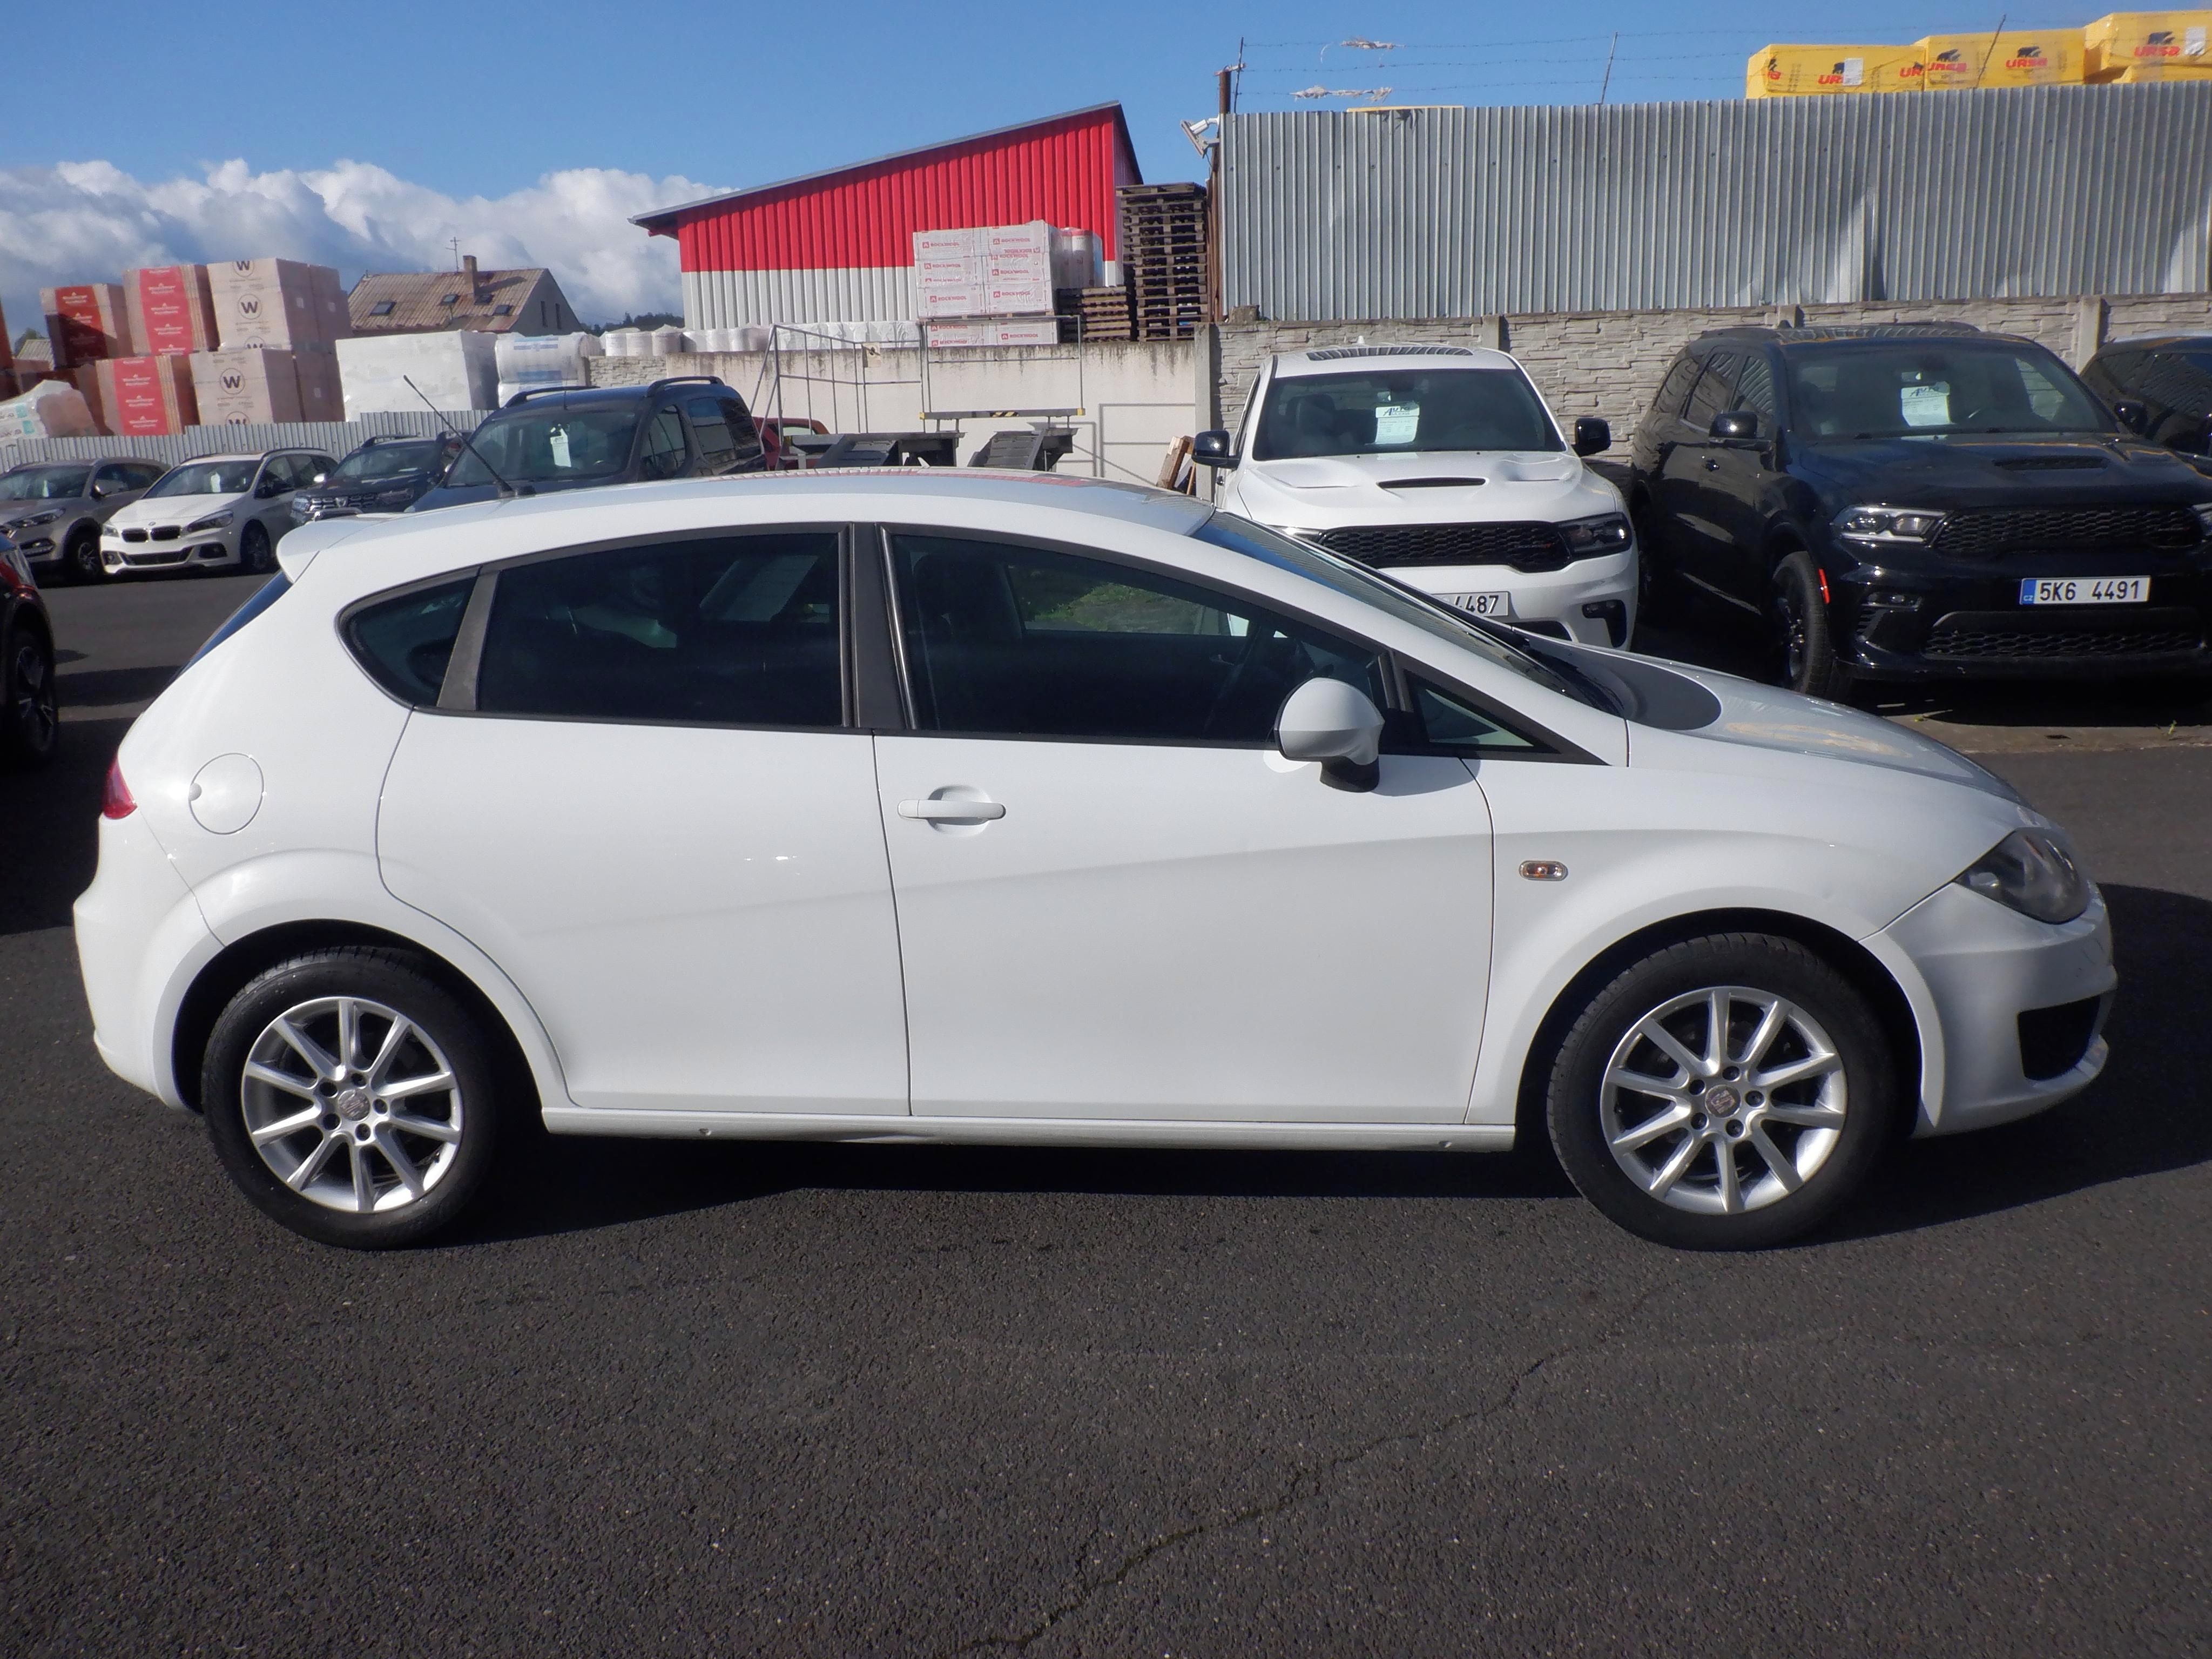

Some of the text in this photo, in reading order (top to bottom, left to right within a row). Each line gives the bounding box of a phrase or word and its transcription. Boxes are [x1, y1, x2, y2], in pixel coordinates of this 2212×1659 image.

[241, 301, 258, 314] W
[223, 375, 240, 388] W
[2039, 580, 2139, 601] 5K6 4491
